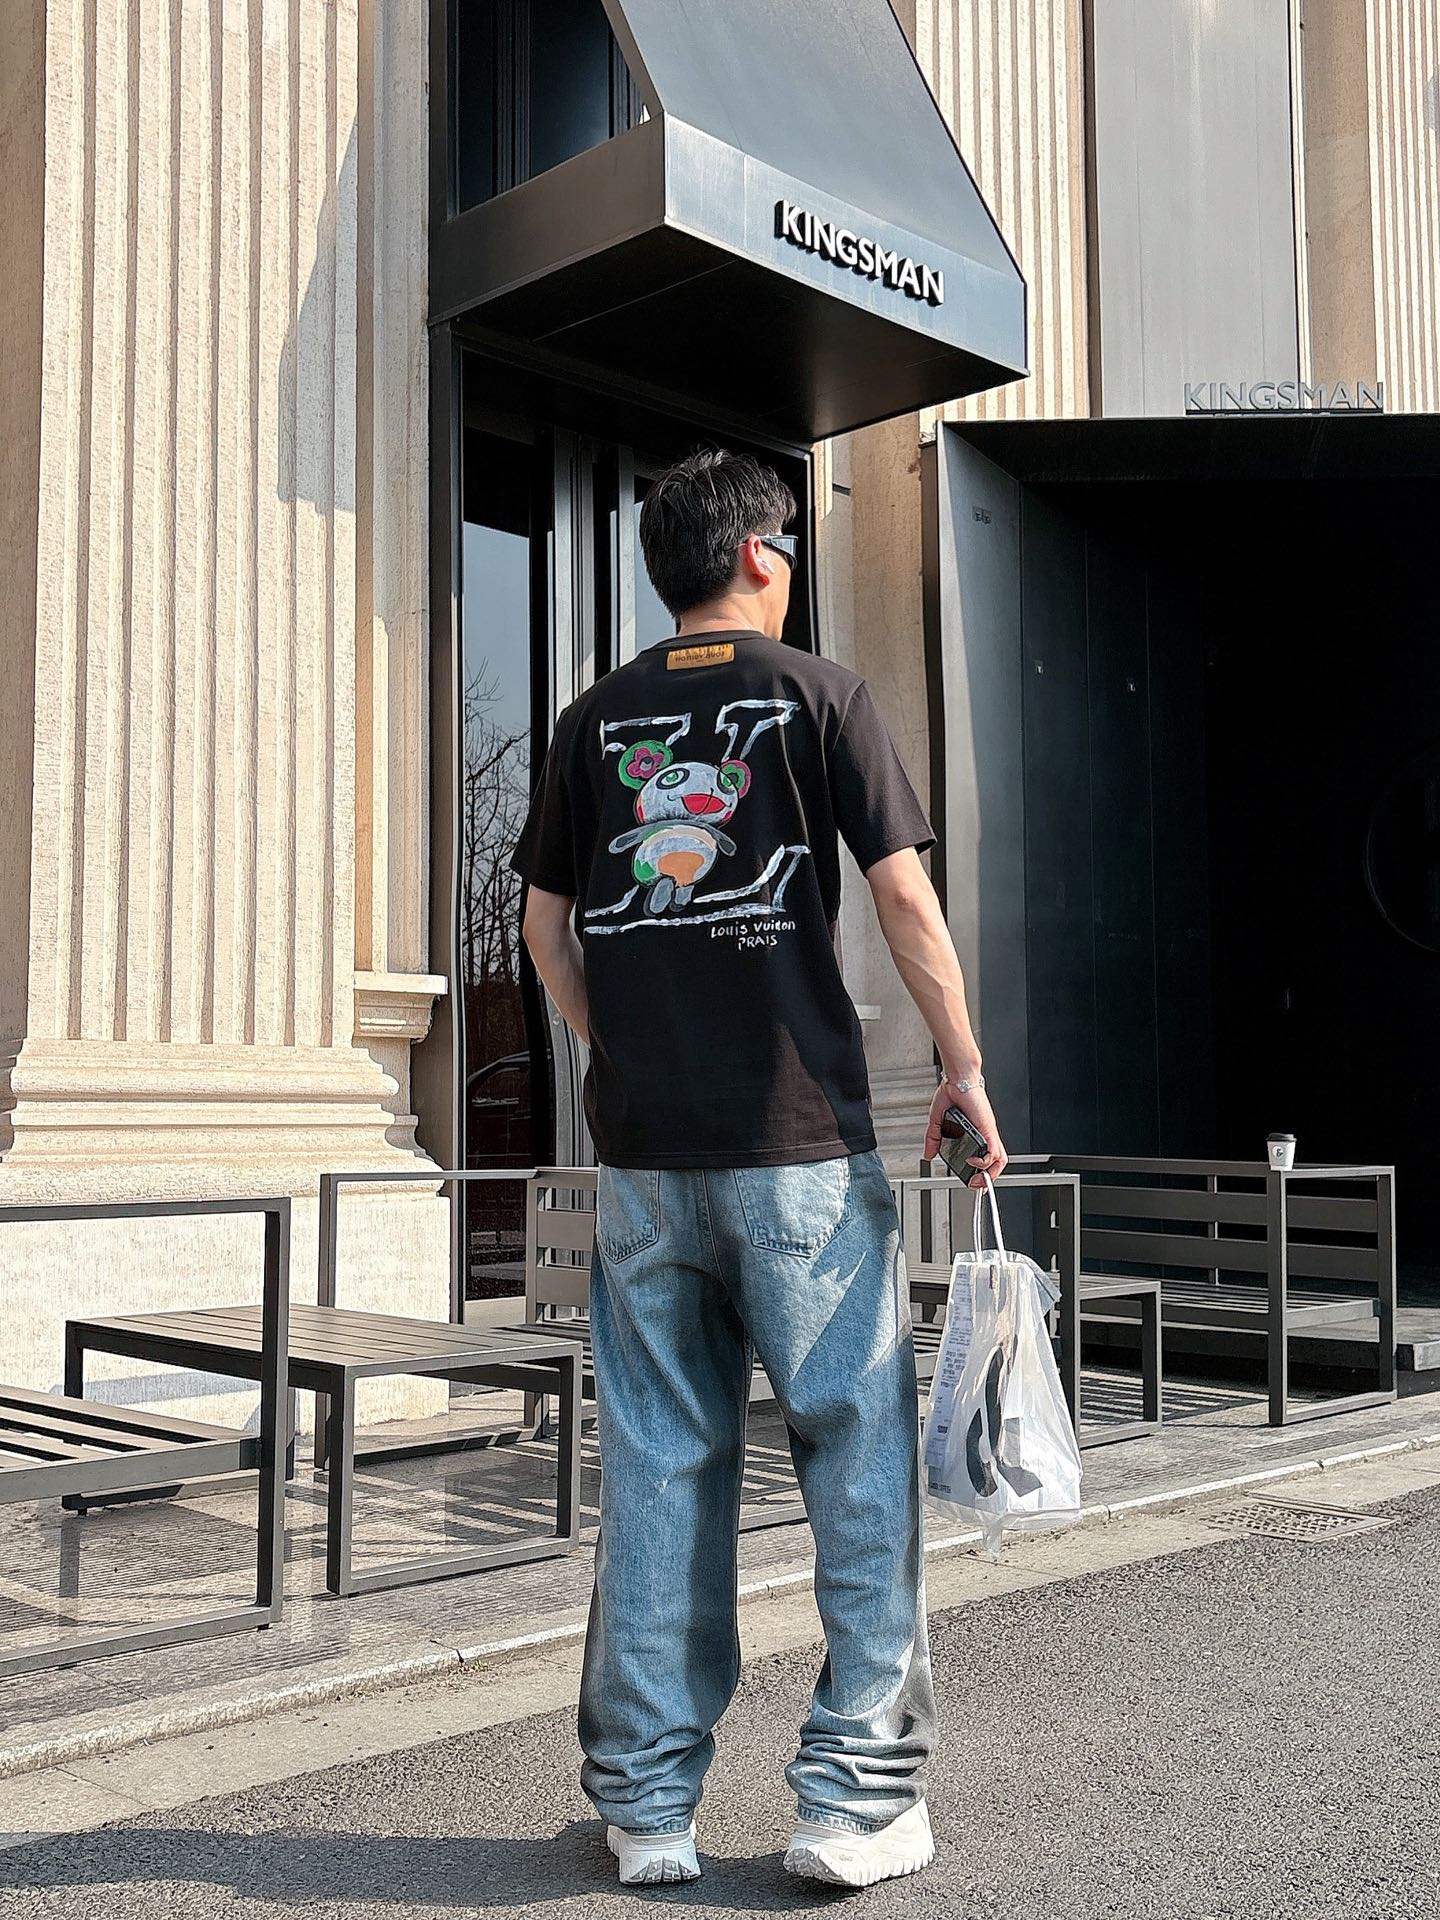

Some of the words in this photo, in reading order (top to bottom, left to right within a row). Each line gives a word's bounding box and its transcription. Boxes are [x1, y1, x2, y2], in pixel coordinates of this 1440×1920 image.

[777, 199, 944, 305] KINGSMAN
[1184, 381, 1383, 409] KINGSMAN
[738, 935, 778, 951] PRAIS
